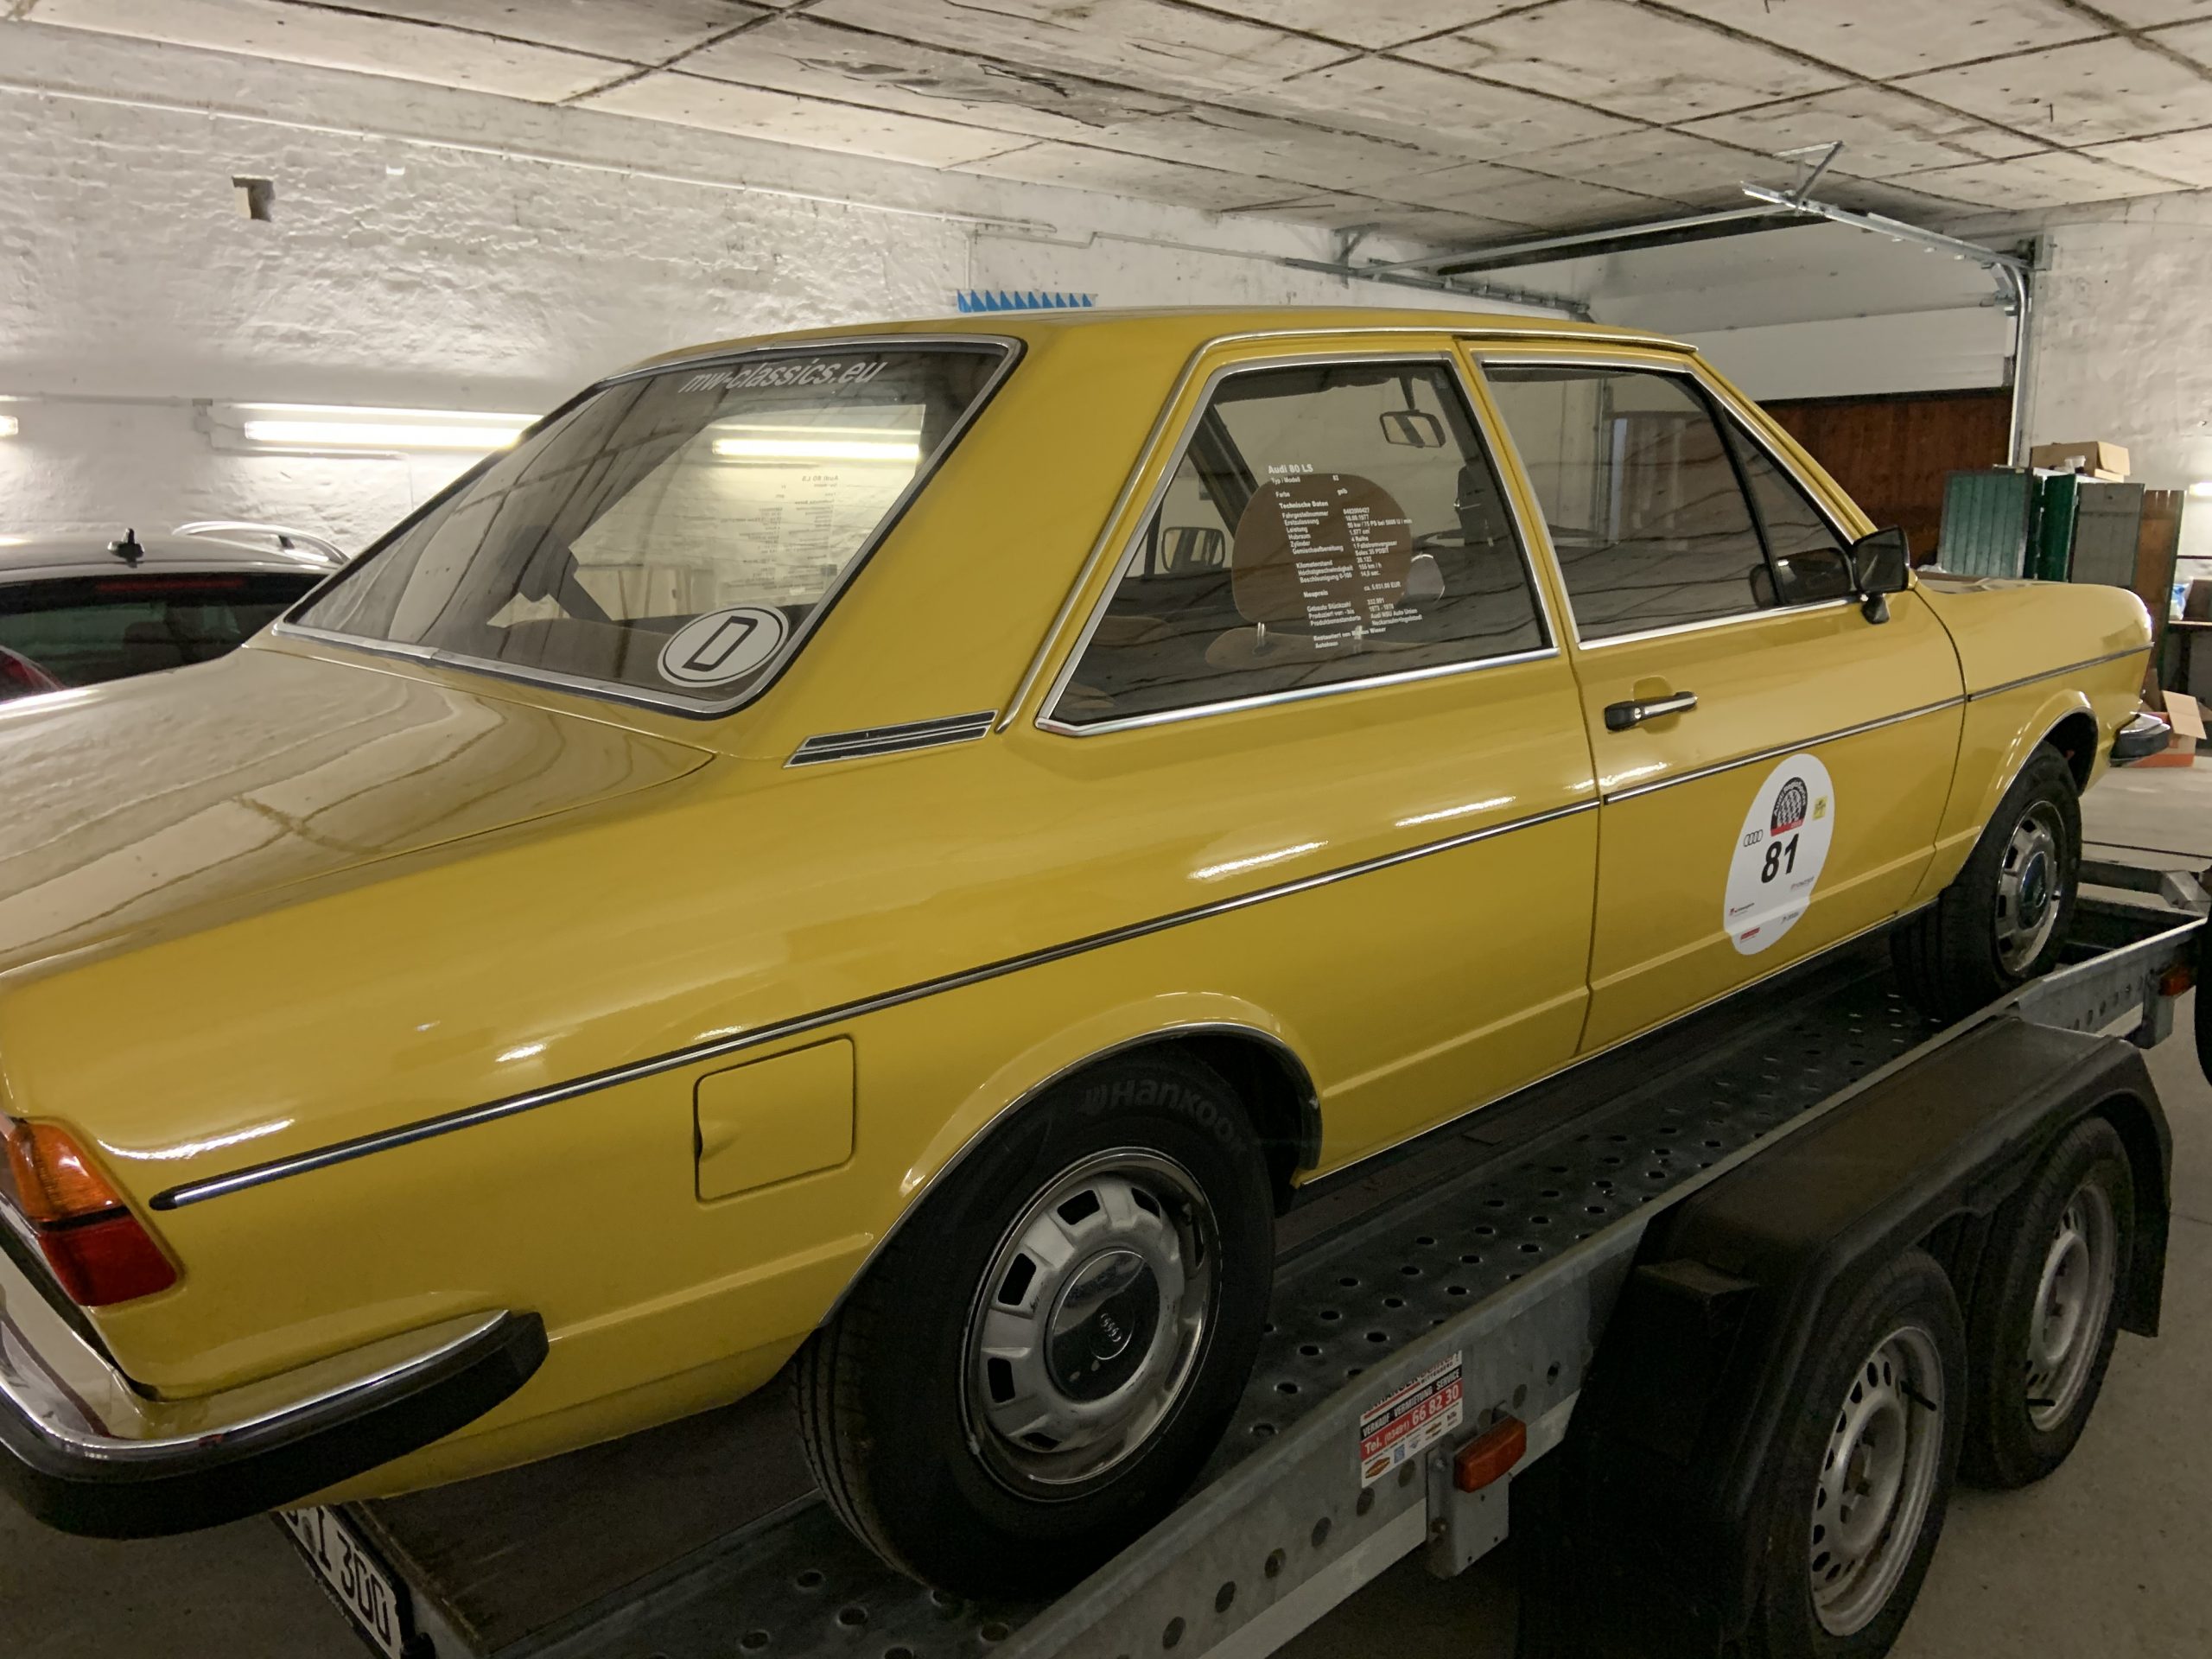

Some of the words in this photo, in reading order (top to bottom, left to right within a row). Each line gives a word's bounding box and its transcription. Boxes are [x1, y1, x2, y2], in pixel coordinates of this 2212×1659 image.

[677, 358, 888, 393] mw-classics.eu
[1268, 465, 1287, 474] Audi
[1288, 464, 1300, 474] 80
[1301, 463, 1313, 473] LS
[1282, 511, 1329, 519] Fahrgestellnummer
[1296, 559, 1332, 569] Kilometerstand
[1303, 589, 1328, 598] Neupreis
[1308, 611, 1334, 620] Produziert
[681, 615, 759, 672] D
[1761, 833, 1799, 884] 81
[1363, 1410, 1390, 1438] VERKAUF
[1394, 1386, 1433, 1418] VERMIETUNG
[1436, 1370, 1460, 1391] SERVICE
[1364, 1437, 1382, 1455] Tel.
[1412, 1406, 1427, 1426] 66
[1428, 1395, 1443, 1414] 82
[1445, 1384, 1459, 1405] 30
